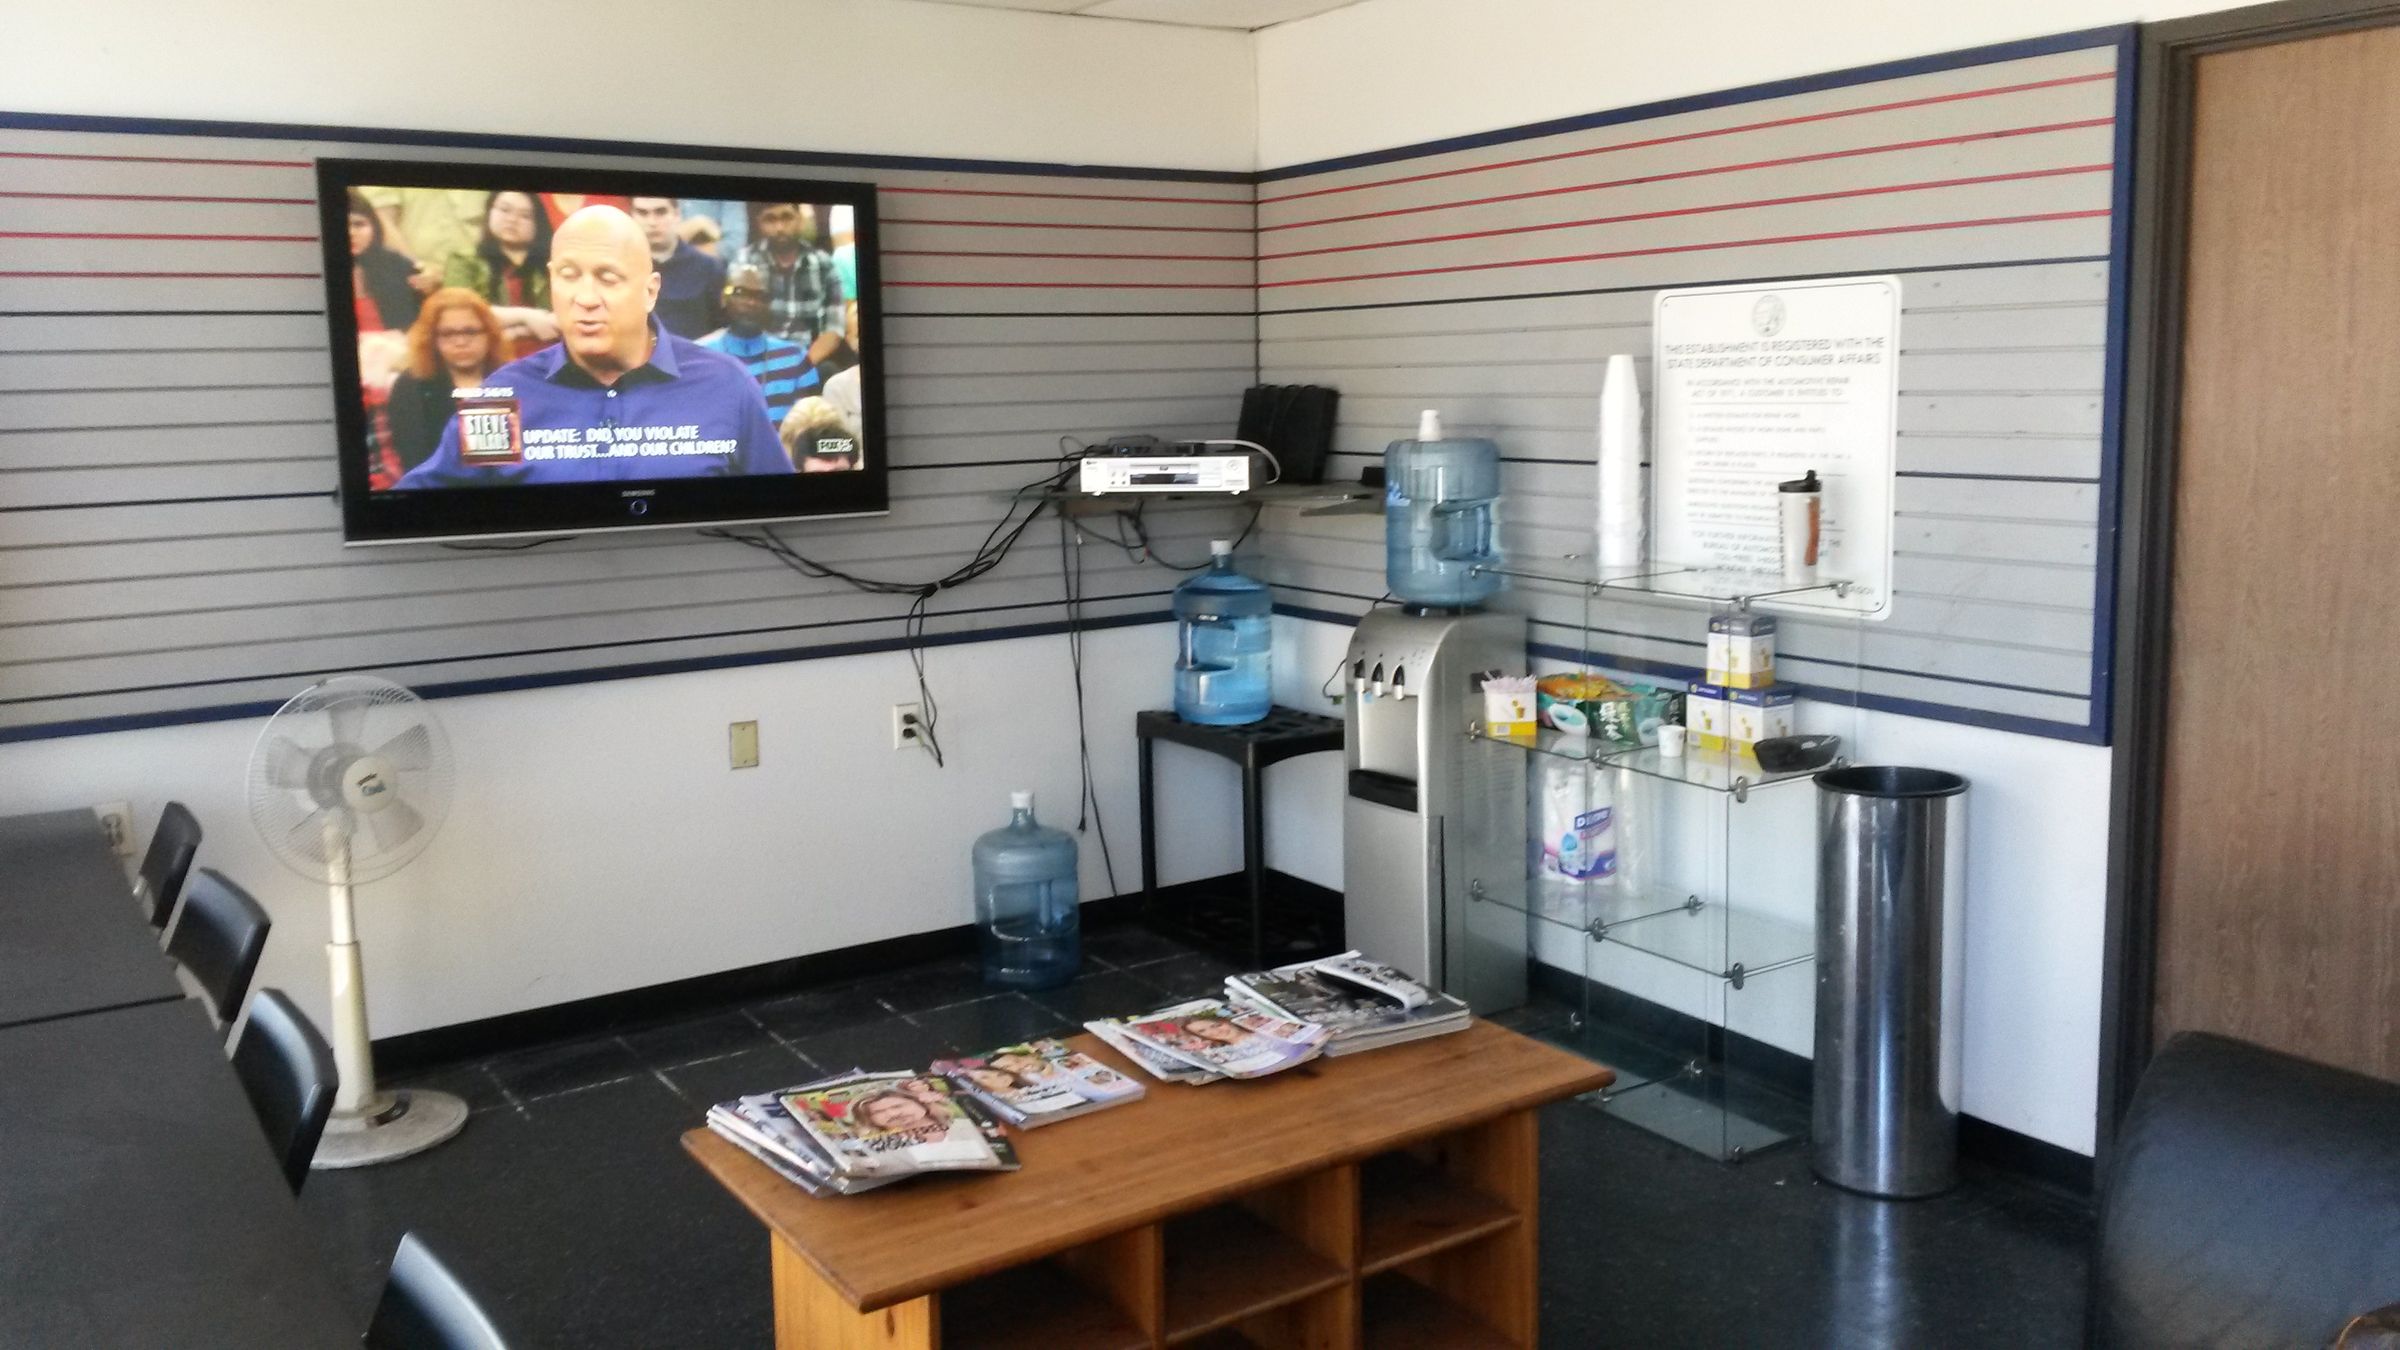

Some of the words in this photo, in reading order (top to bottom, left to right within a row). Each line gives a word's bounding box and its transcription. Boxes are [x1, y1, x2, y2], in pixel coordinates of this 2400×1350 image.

[522, 429, 581, 444] UPDATE:
[614, 427, 643, 441] YOU
[644, 425, 699, 440] VIOLATE
[524, 445, 555, 460] OUR
[640, 442, 668, 456] OUR
[669, 440, 737, 455] CHILDREN?
